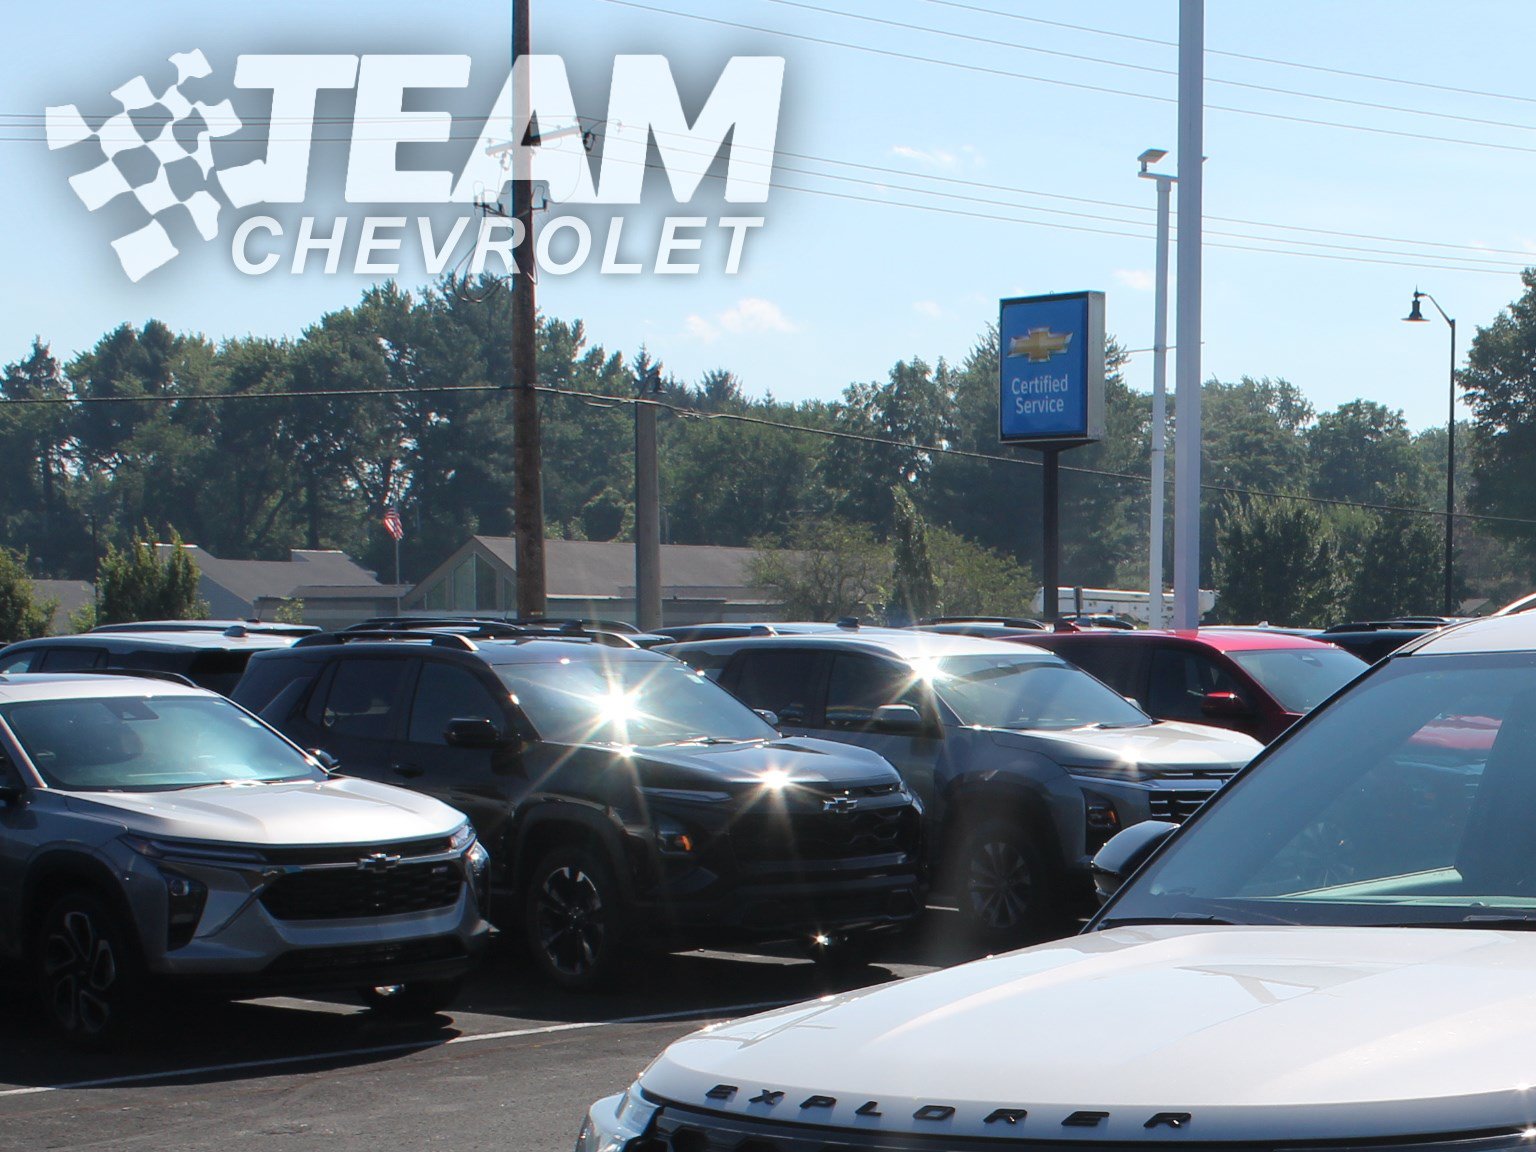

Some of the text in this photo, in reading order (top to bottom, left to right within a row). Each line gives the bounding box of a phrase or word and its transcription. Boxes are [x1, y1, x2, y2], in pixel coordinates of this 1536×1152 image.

[1011, 374, 1068, 394] Certified
[1016, 396, 1064, 414] Service
[705, 1084, 1192, 1128] EXPLORER
